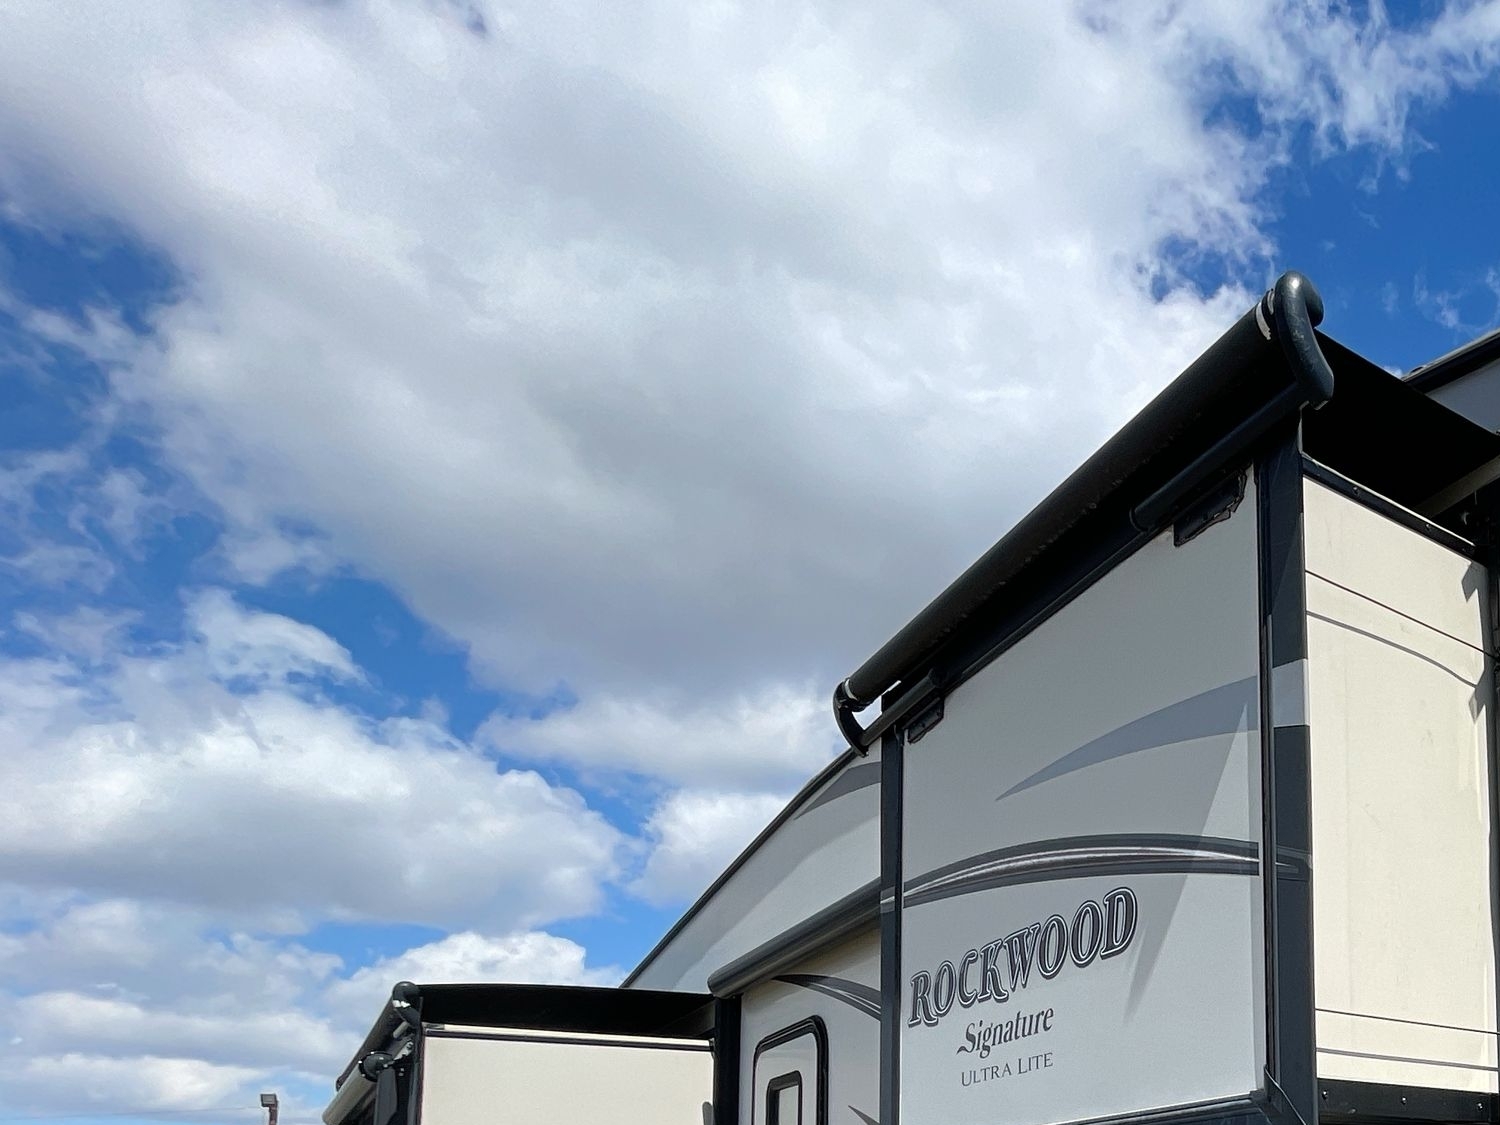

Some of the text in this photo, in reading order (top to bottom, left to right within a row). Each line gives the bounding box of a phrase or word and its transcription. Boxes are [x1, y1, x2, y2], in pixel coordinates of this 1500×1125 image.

[907, 886, 1139, 1029] ROCKWOOD
[956, 1007, 1055, 1059] Signature
[961, 1052, 1054, 1087] ULTRA LITE
